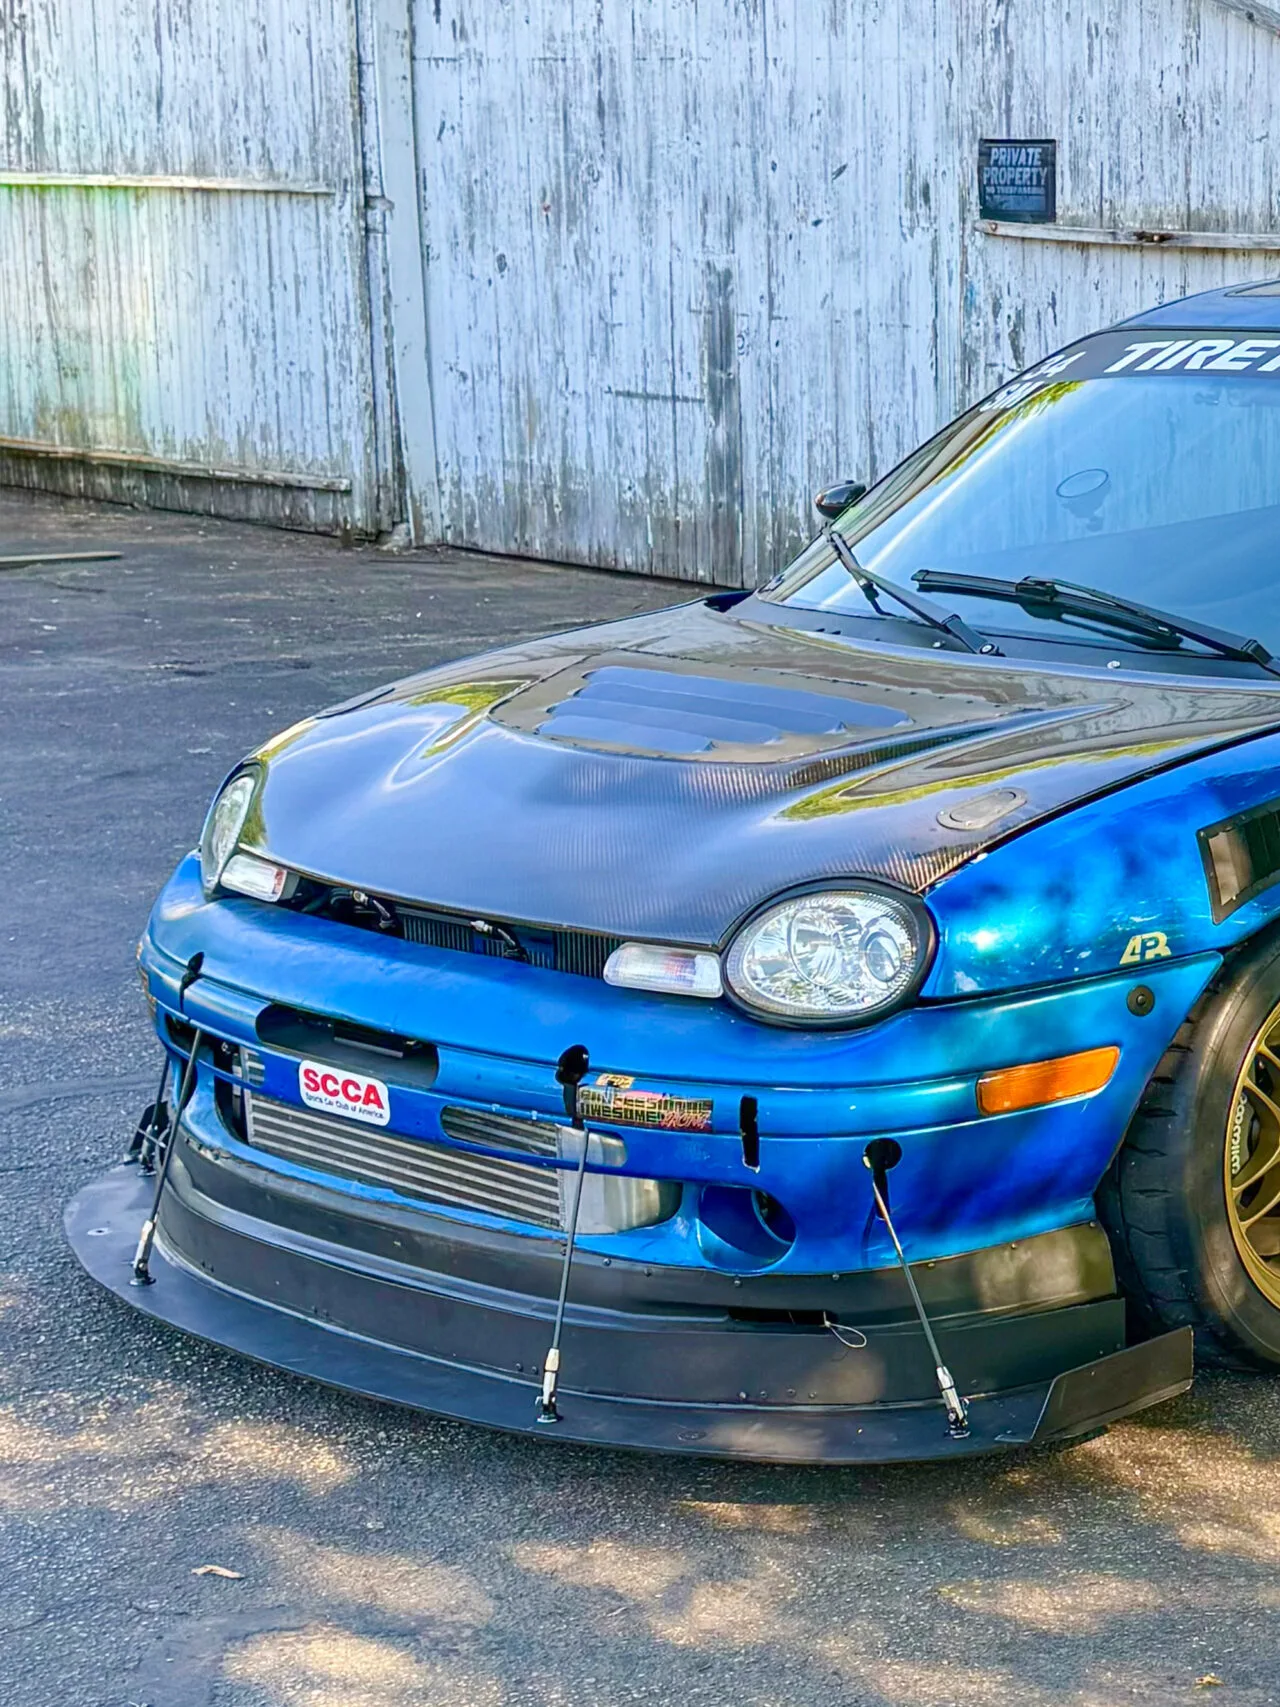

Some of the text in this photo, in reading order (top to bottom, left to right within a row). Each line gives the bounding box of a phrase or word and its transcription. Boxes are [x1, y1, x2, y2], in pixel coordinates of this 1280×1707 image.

[990, 147, 1042, 166] PRIVATE
[983, 167, 1047, 185] PROPERTY
[303, 1068, 385, 1110] SCCA
[580, 1102, 658, 1123] AWESOME
